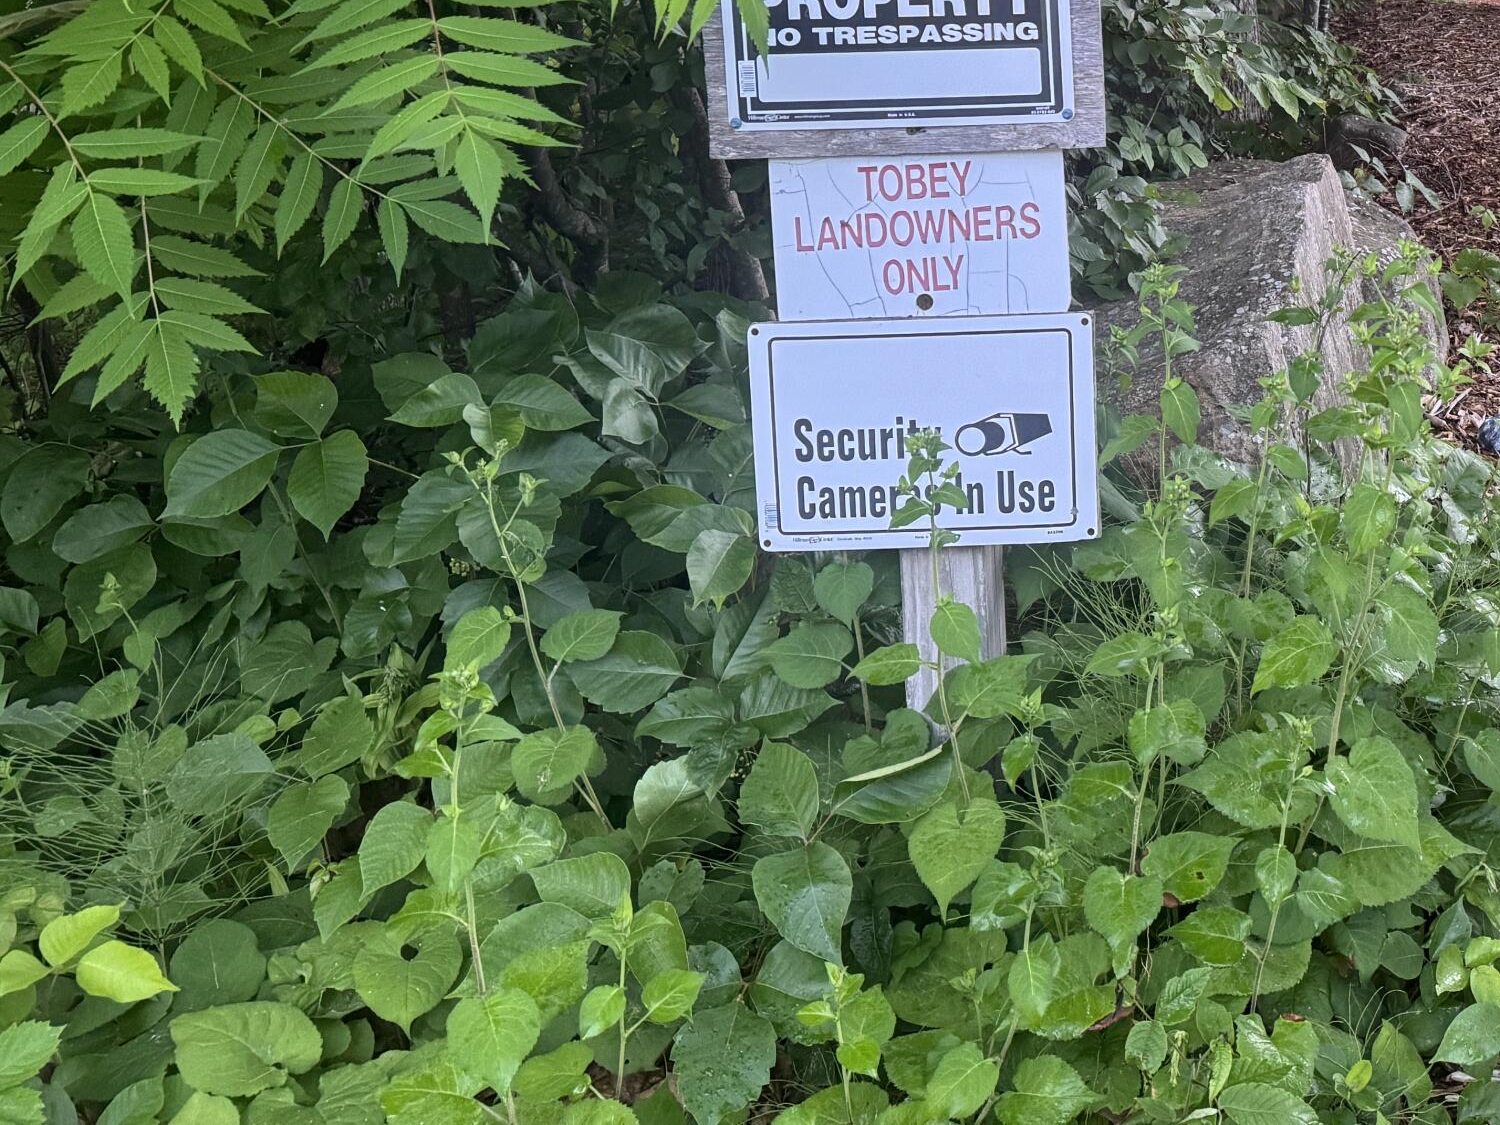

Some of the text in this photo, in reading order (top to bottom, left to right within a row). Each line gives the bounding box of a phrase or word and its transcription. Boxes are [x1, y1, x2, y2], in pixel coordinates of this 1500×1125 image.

[811, 22, 1039, 46] TRESPASSING
[857, 160, 973, 202] TOBEY
[794, 202, 1042, 252] LANDOWNERS
[882, 254, 965, 296] ONLY
[997, 470, 1056, 513] Use
